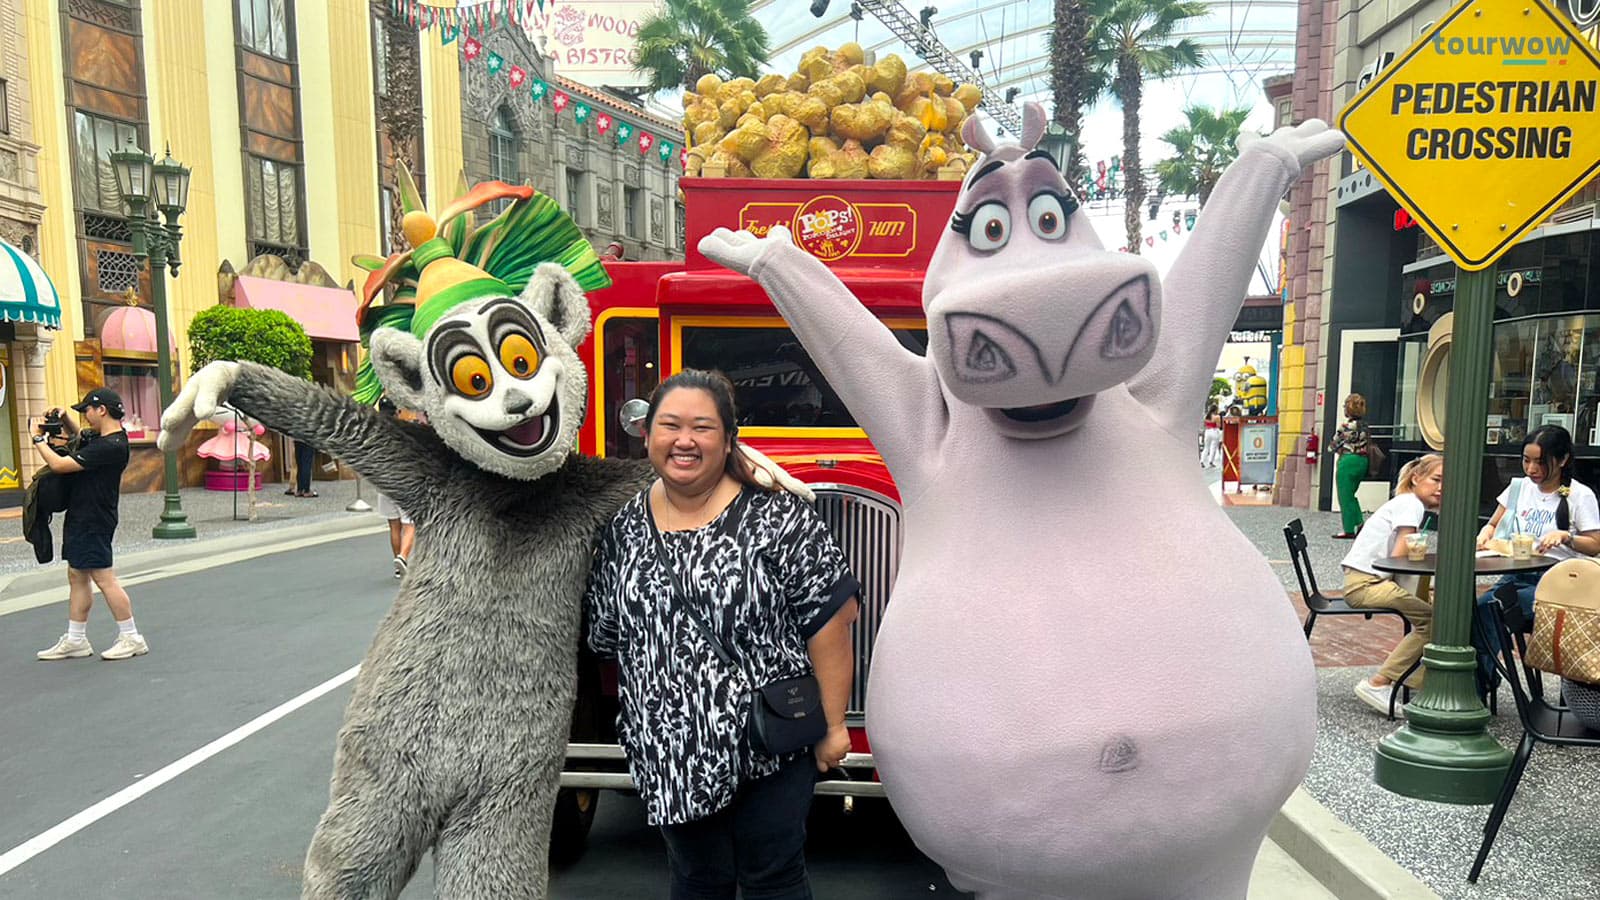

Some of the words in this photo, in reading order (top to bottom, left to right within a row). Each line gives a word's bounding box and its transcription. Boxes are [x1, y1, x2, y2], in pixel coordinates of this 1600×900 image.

[1391, 80, 1596, 116] PEDESTRIAN
[1406, 126, 1572, 161] CROSSING
[868, 220, 907, 237] HOT!
